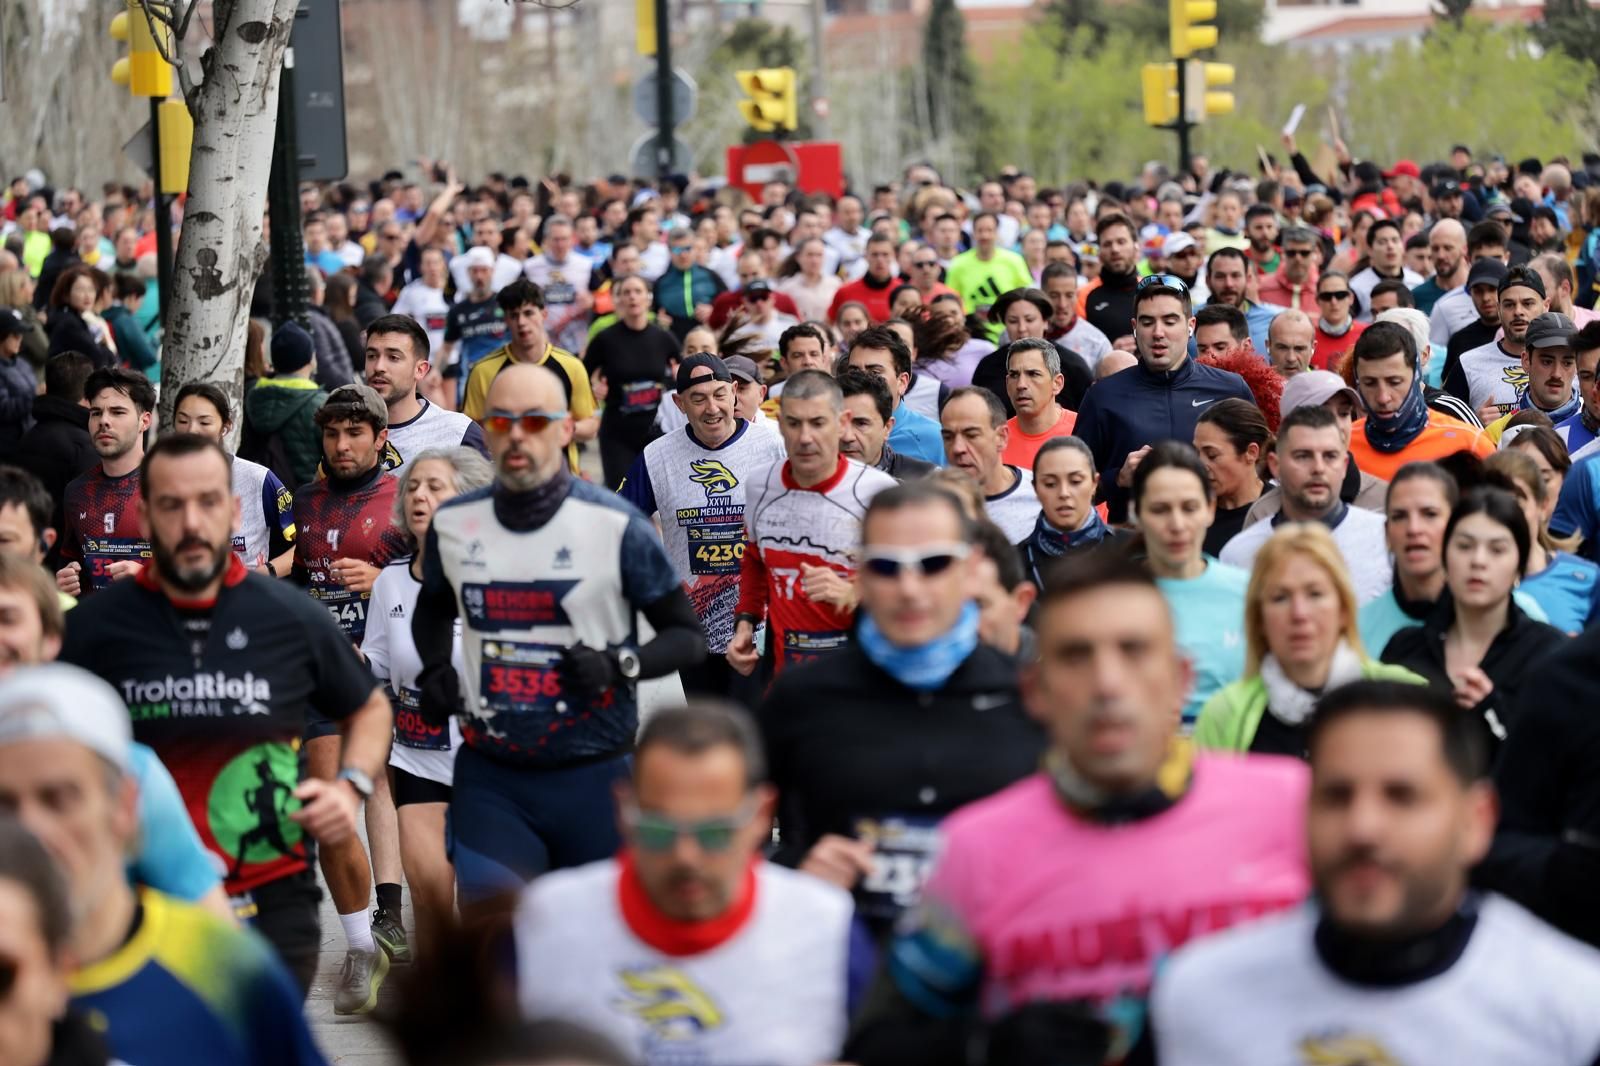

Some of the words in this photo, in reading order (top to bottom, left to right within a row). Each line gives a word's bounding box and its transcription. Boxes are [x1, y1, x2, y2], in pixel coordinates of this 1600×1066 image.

[708, 497, 730, 507] XXVII
[677, 509, 699, 519] RODI
[700, 507, 724, 516] MEDIA
[696, 543, 746, 562] 4230
[488, 667, 562, 697] 3536
